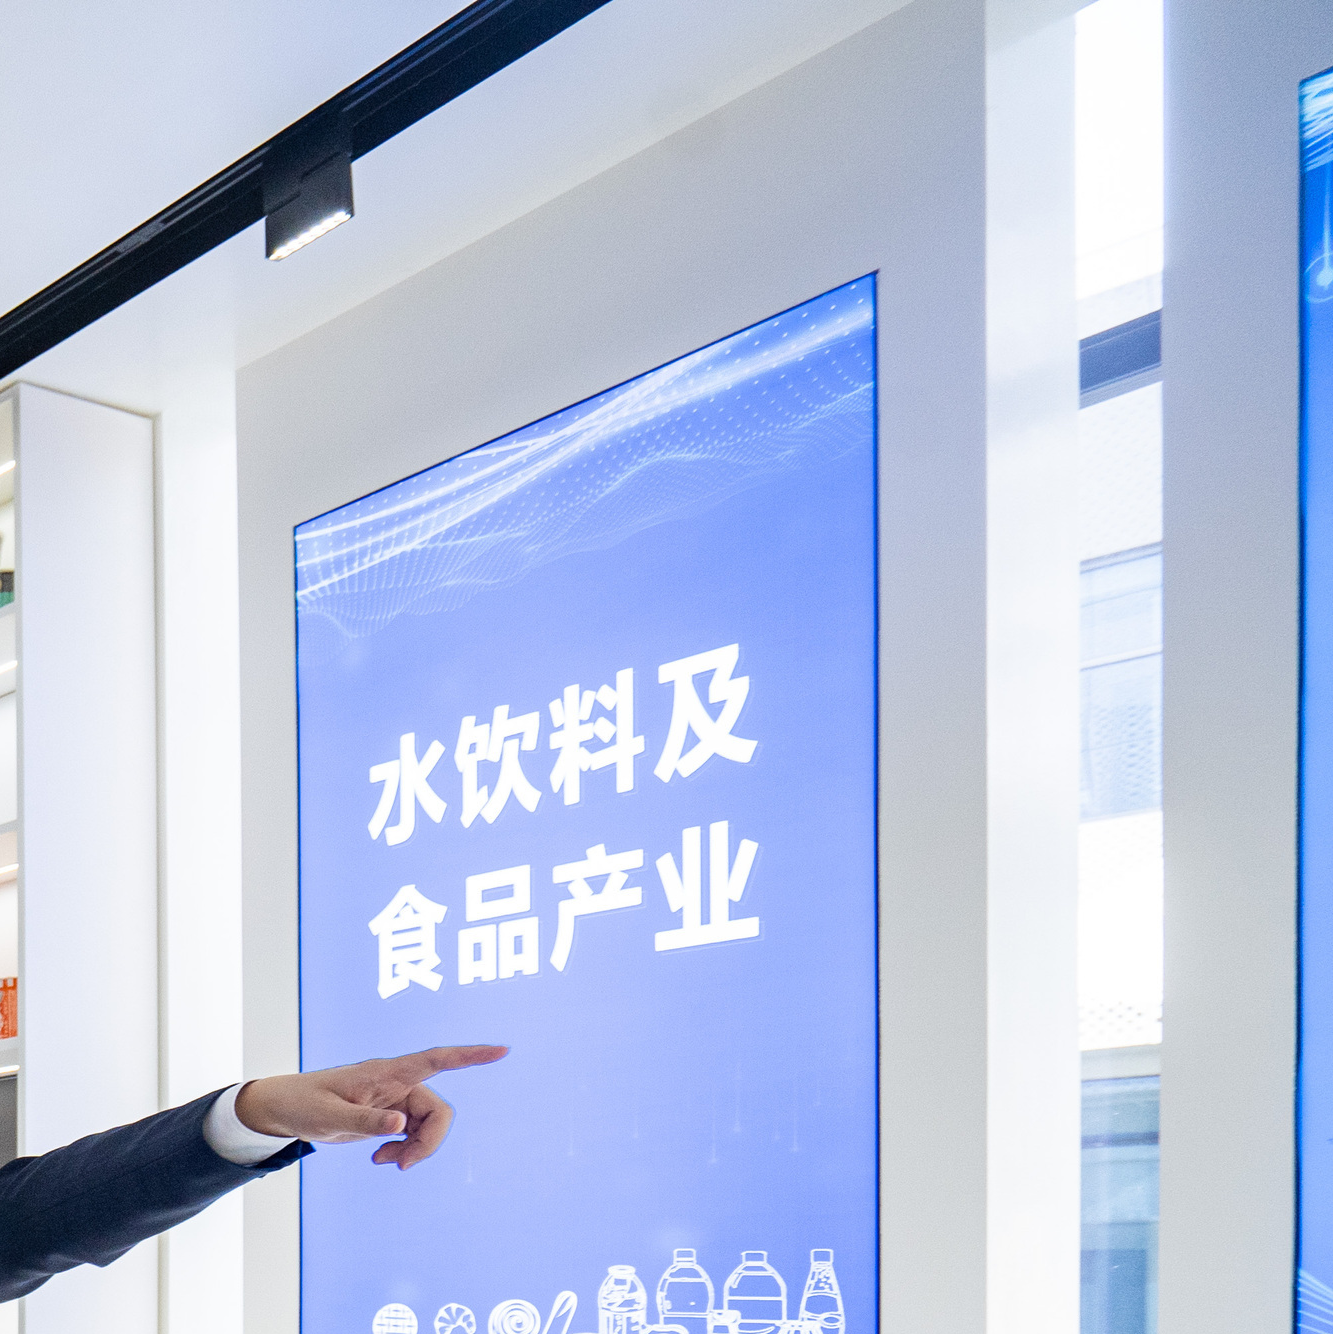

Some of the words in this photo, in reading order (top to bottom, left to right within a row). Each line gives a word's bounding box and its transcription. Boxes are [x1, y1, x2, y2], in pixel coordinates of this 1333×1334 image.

[367, 642, 759, 847] 水饮料及
[367, 820, 760, 1000] 食品产业
